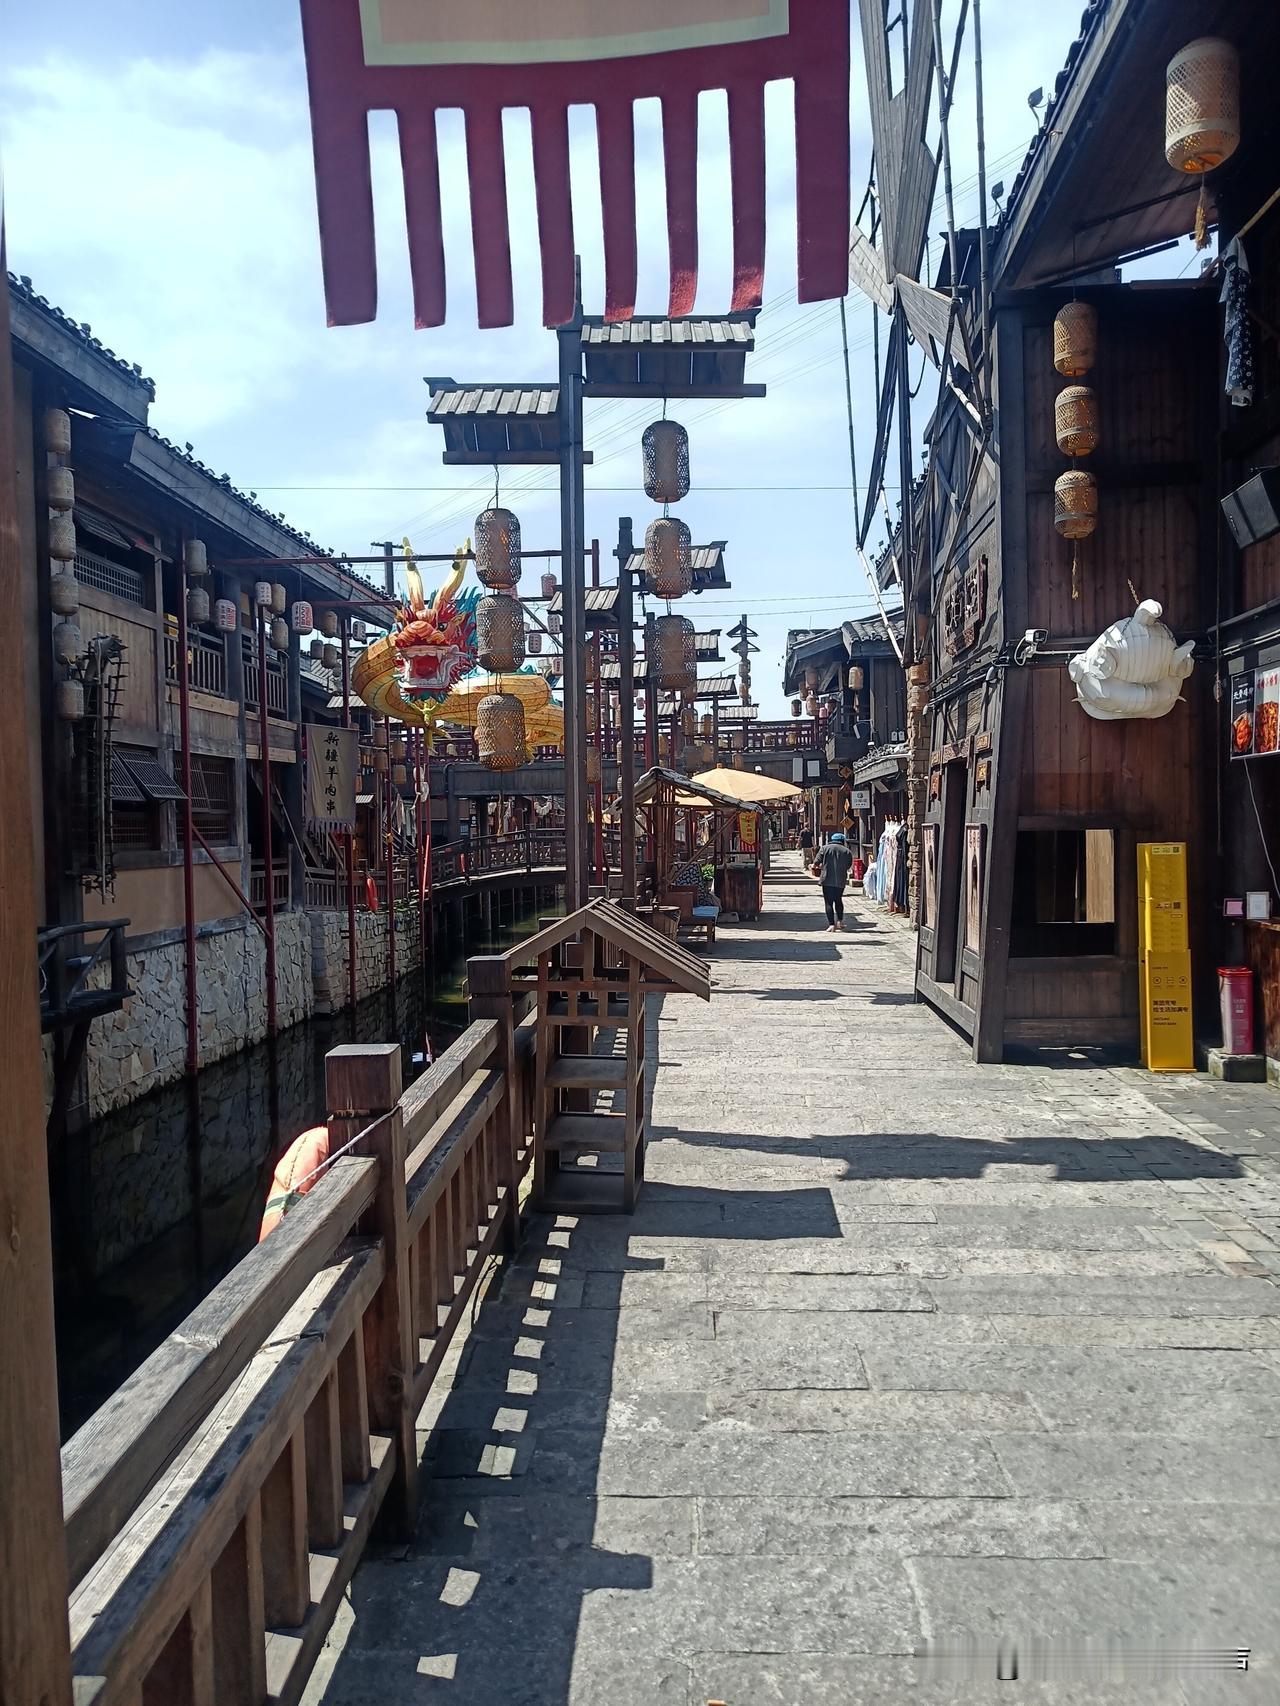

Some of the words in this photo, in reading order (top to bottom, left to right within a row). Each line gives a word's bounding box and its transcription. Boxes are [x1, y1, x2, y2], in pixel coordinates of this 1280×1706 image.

[323, 732, 340, 816] 新疆羊肉串
